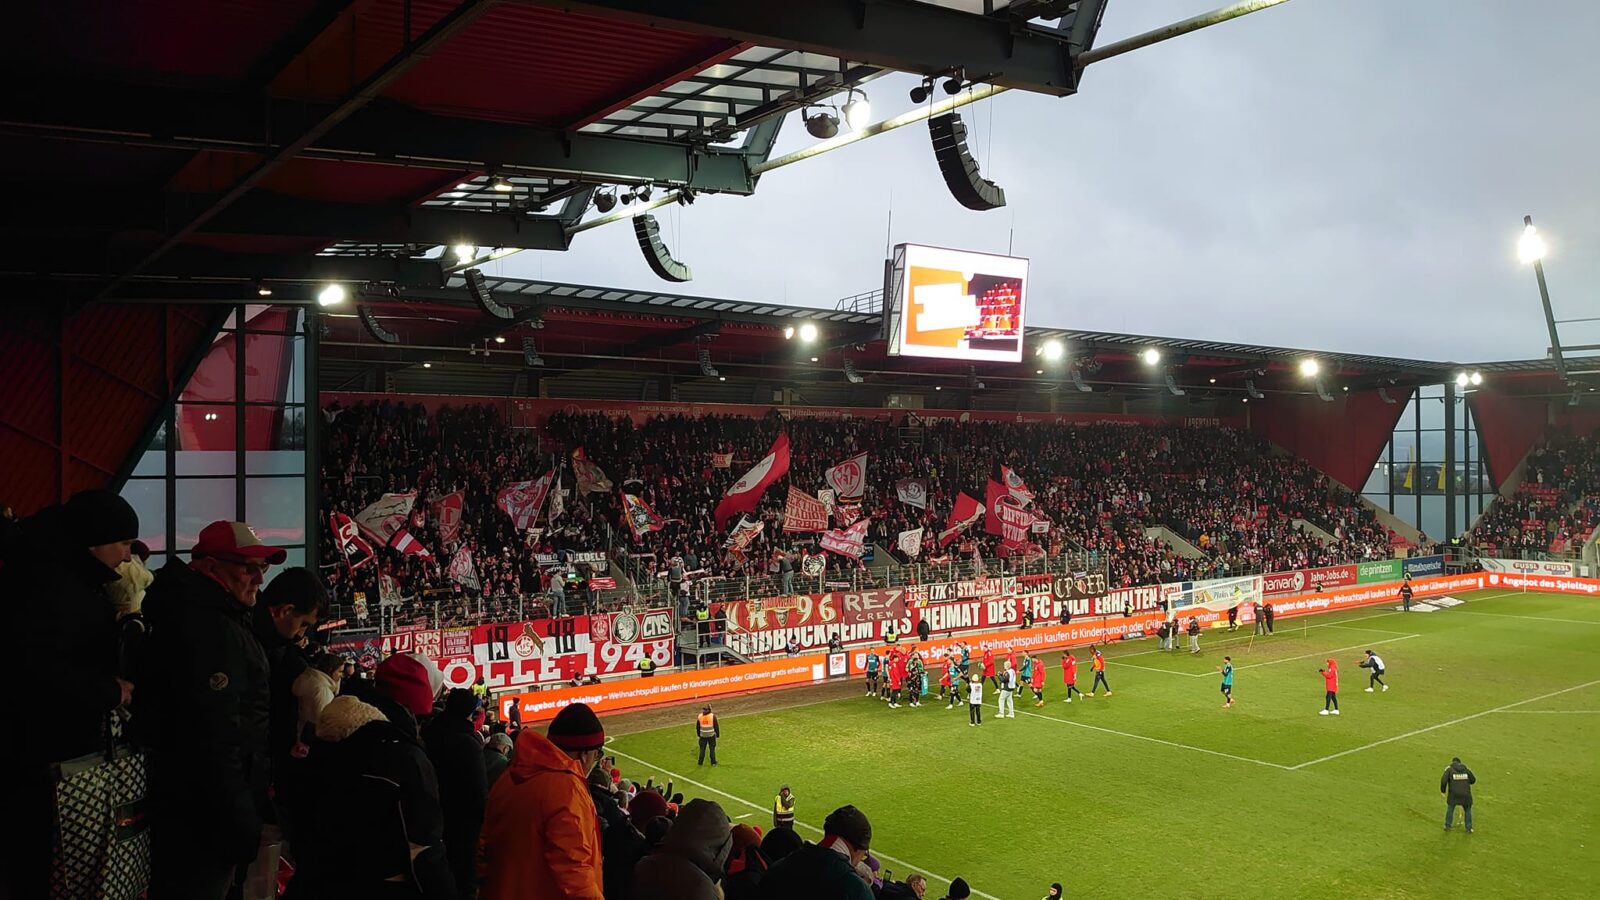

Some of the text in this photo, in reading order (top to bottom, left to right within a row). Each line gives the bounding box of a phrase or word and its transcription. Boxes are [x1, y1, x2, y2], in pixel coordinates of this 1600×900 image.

[1503, 577, 1597, 594] Angebot des Spieltags
[987, 599, 1018, 624] DES
[979, 633, 1043, 652] Weihnachtspulli
[1044, 630, 1070, 643] kaufen
[1071, 628, 1078, 638] &
[1079, 621, 1128, 638] Kinderpunsch
[1129, 622, 1144, 631] oder
[433, 641, 671, 690] ÖLLE 1948
[524, 701, 555, 712] Angebot
[556, 698, 570, 708] des
[608, 686, 659, 701] Weihnachtspulli
[660, 682, 682, 693] kaufen
[682, 682, 689, 690] &
[689, 676, 729, 689] Kinderpunsch
[730, 673, 744, 683] oder
[744, 670, 770, 681] Glühwein
[771, 668, 787, 679] gratis
[787, 666, 809, 677] erhalten
